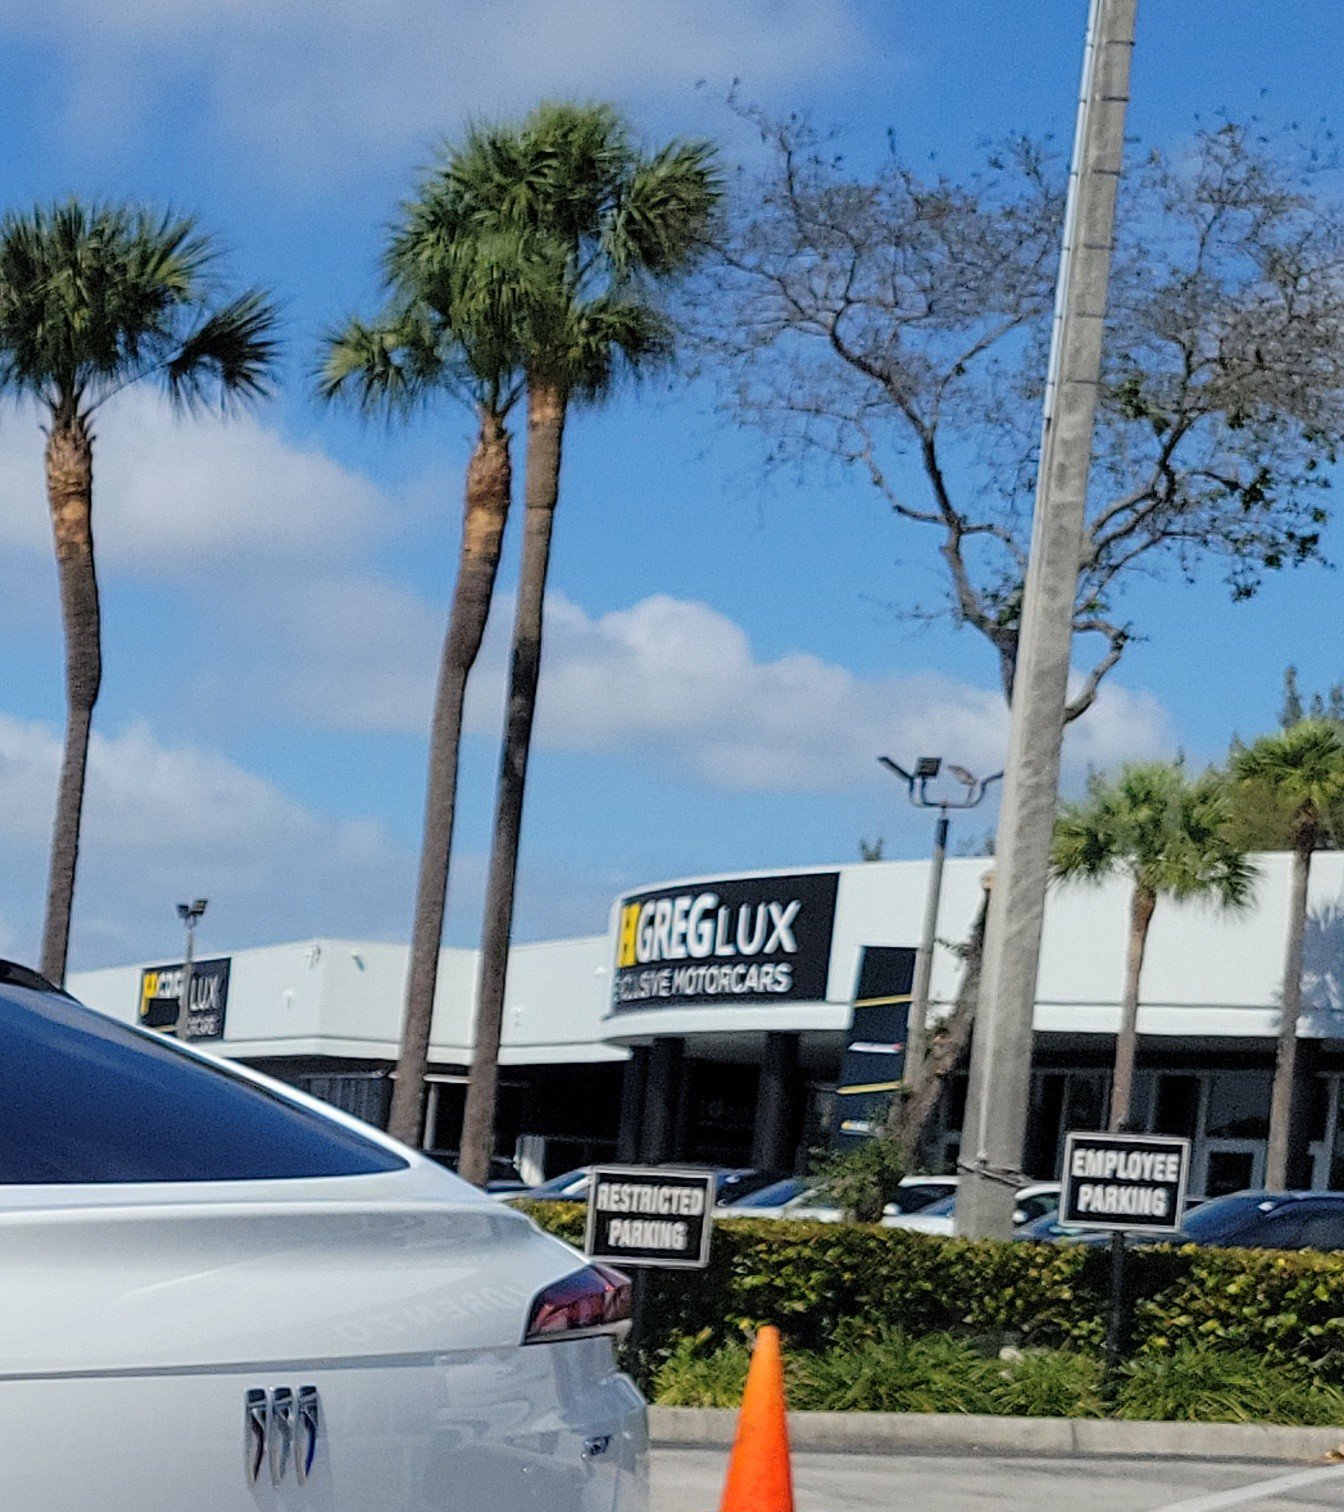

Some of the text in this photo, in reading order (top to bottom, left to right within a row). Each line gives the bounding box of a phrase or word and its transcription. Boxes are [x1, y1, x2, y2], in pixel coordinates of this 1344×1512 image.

[673, 962, 794, 995] MOTORCARS
[1072, 1148, 1180, 1182] EMPLOYEE
[596, 1182, 705, 1216] RESTRICTED
[1077, 1184, 1169, 1217] PARKING
[607, 1218, 688, 1250] PARKING
